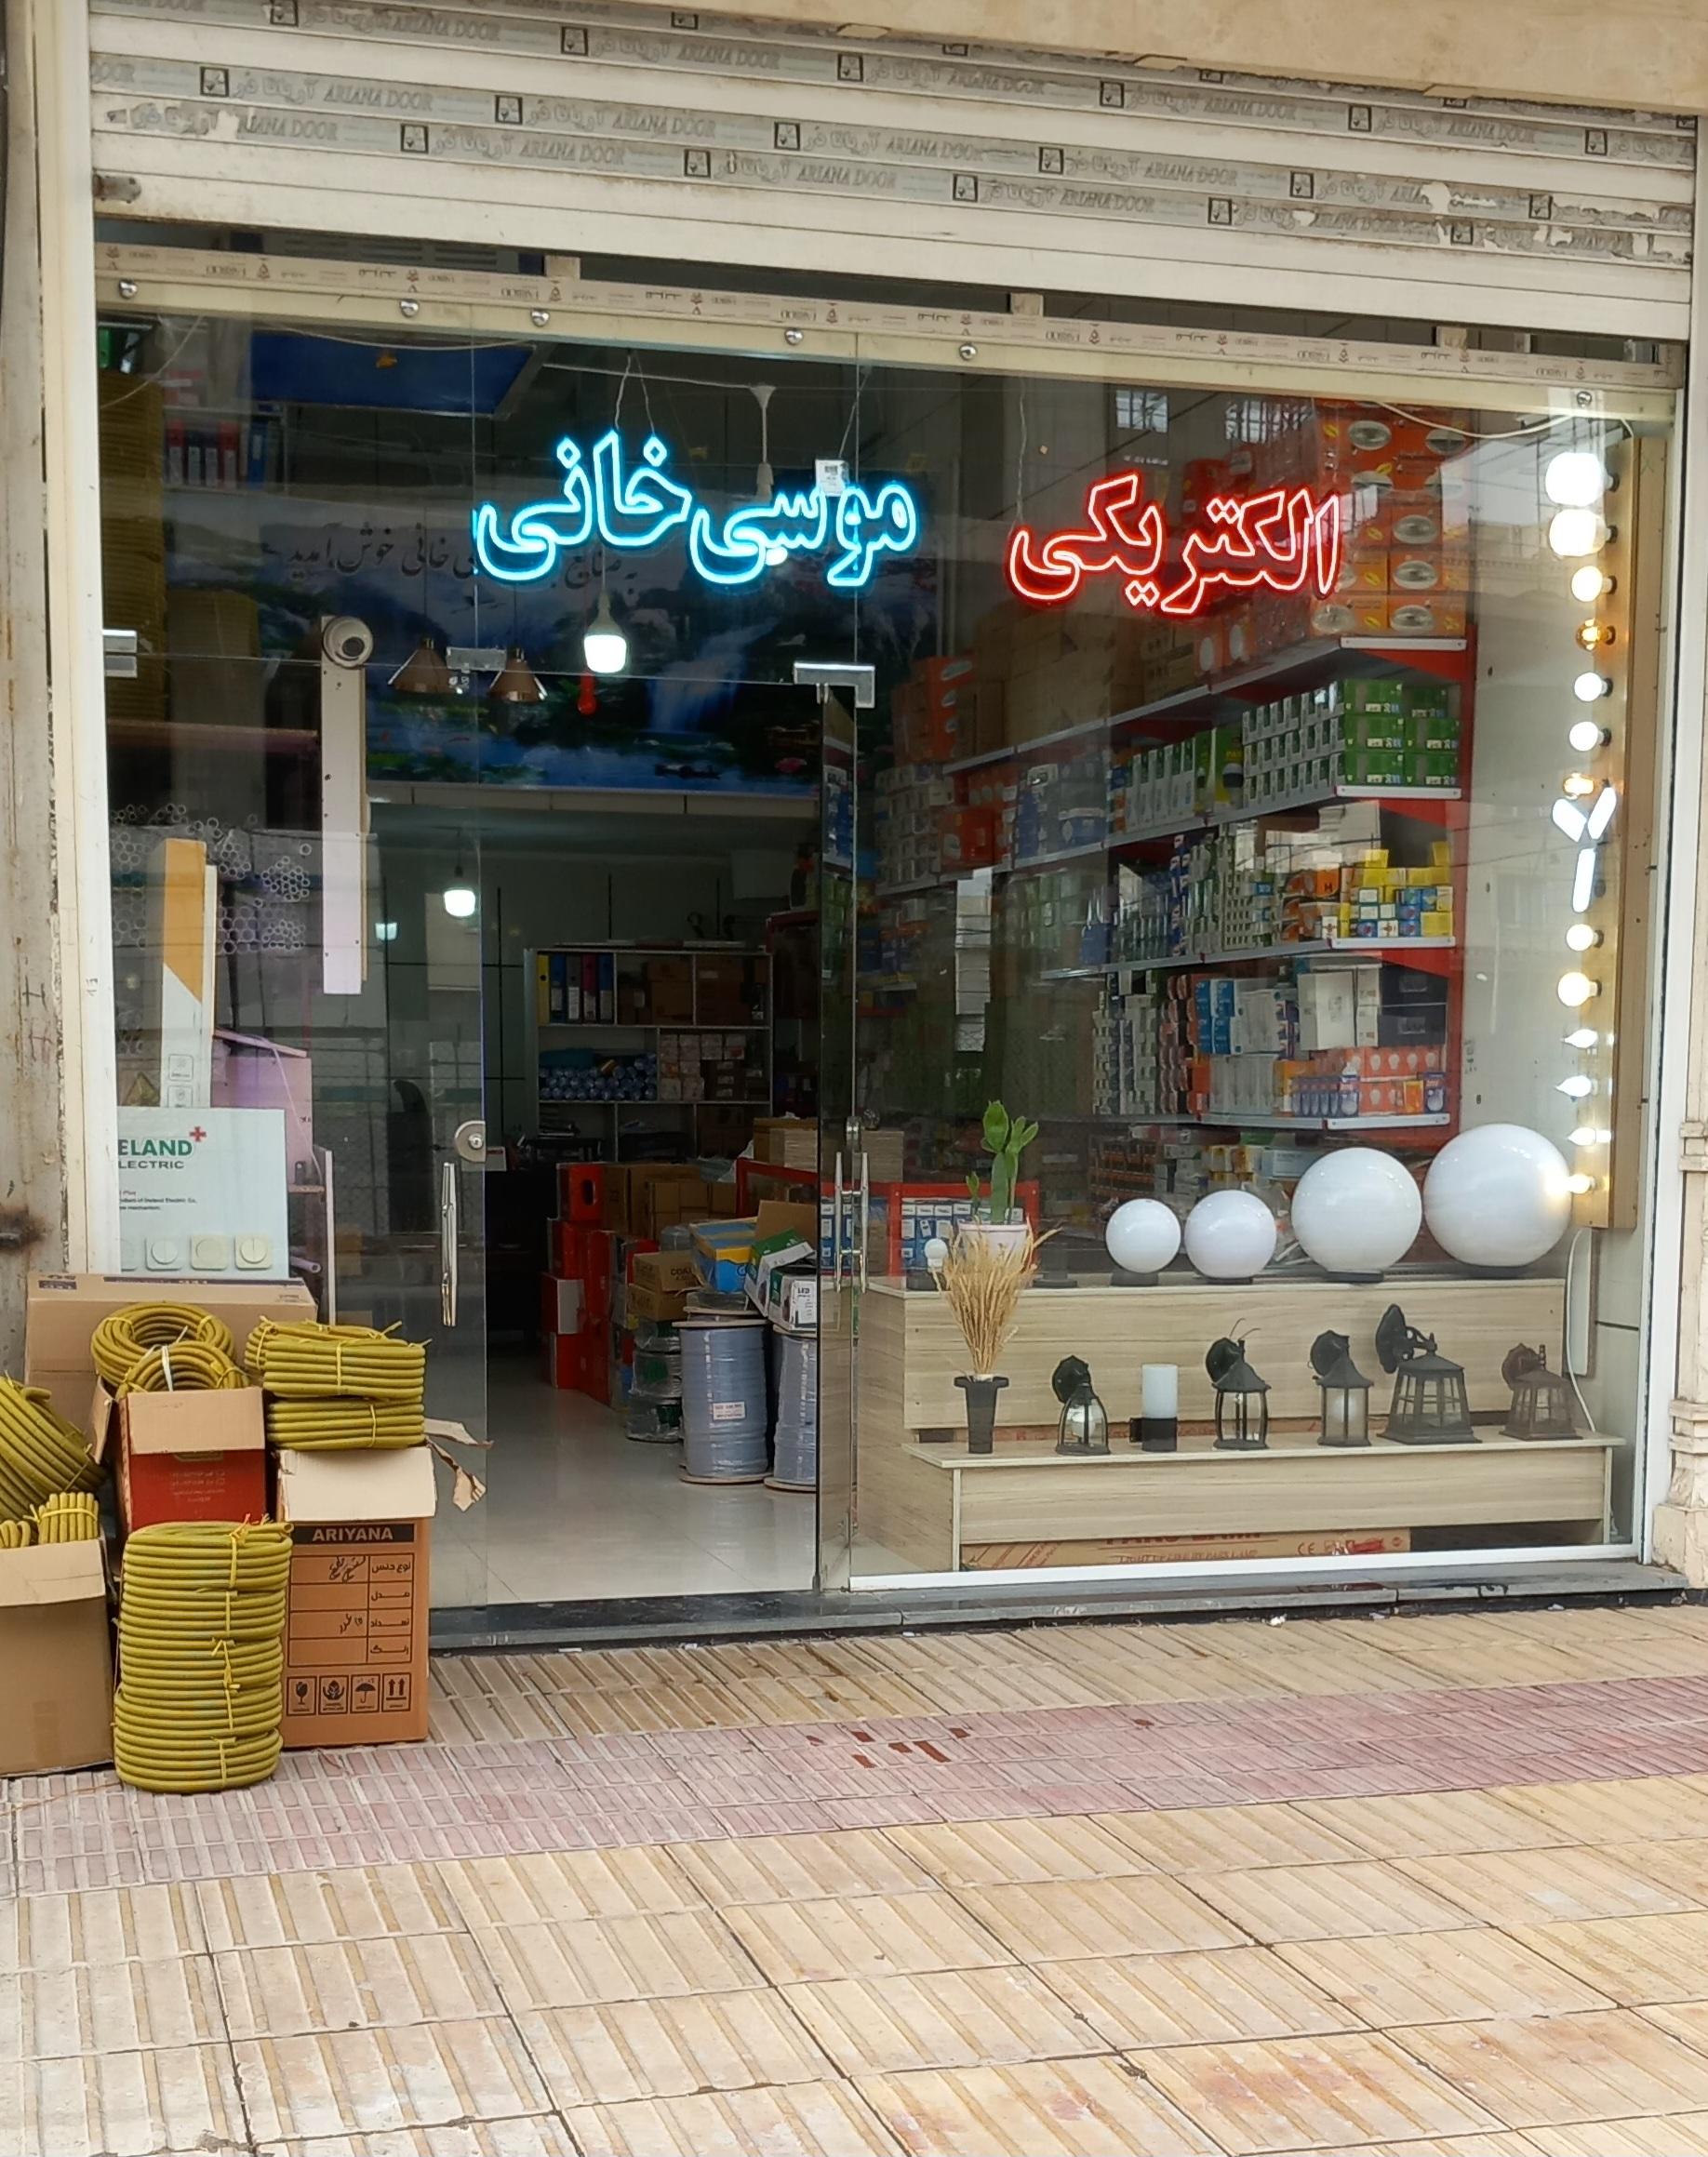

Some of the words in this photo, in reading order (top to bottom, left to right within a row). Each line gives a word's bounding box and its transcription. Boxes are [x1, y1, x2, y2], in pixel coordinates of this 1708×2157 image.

[475, 430, 693, 583] خانی
[689, 483, 917, 588] موسی
[1009, 473, 1341, 615] الکتریکی
[336, 523, 394, 575] خوش
[312, 1526, 394, 1542] ARIYANA
[395, 1562, 411, 1573] نوع
